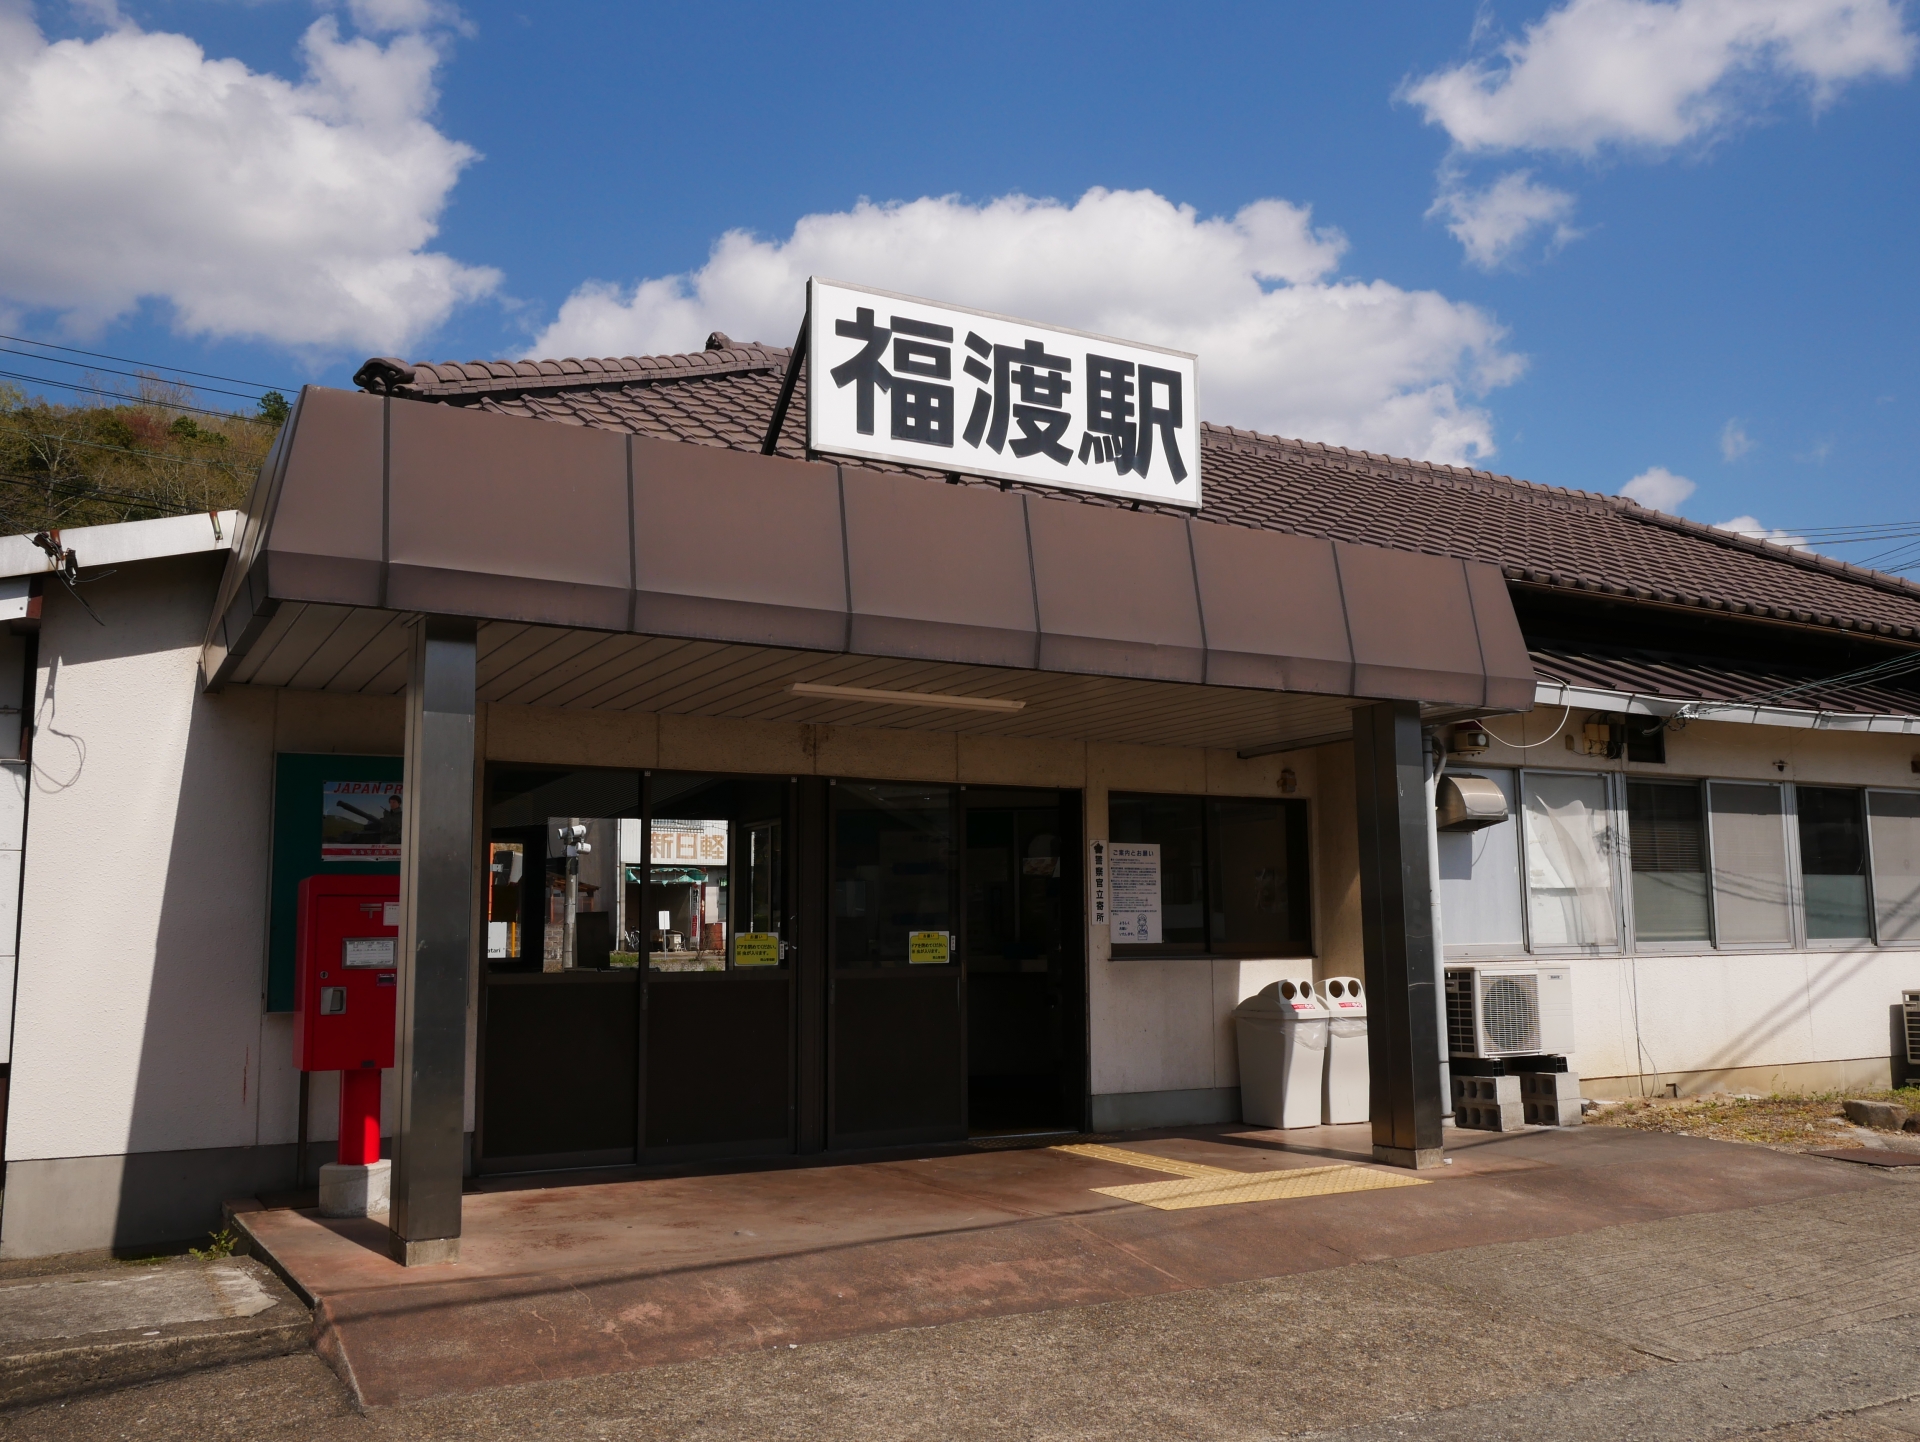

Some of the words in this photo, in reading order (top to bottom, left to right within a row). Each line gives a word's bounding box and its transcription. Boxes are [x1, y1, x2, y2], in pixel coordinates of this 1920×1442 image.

[830, 306, 1188, 484] 福渡駅
[333, 782, 381, 794] JAPAN
[650, 832, 725, 860] 新日軽
[1113, 849, 1154, 857] ご案内とお願い
[1095, 855, 1104, 922] 警察官立寄所
